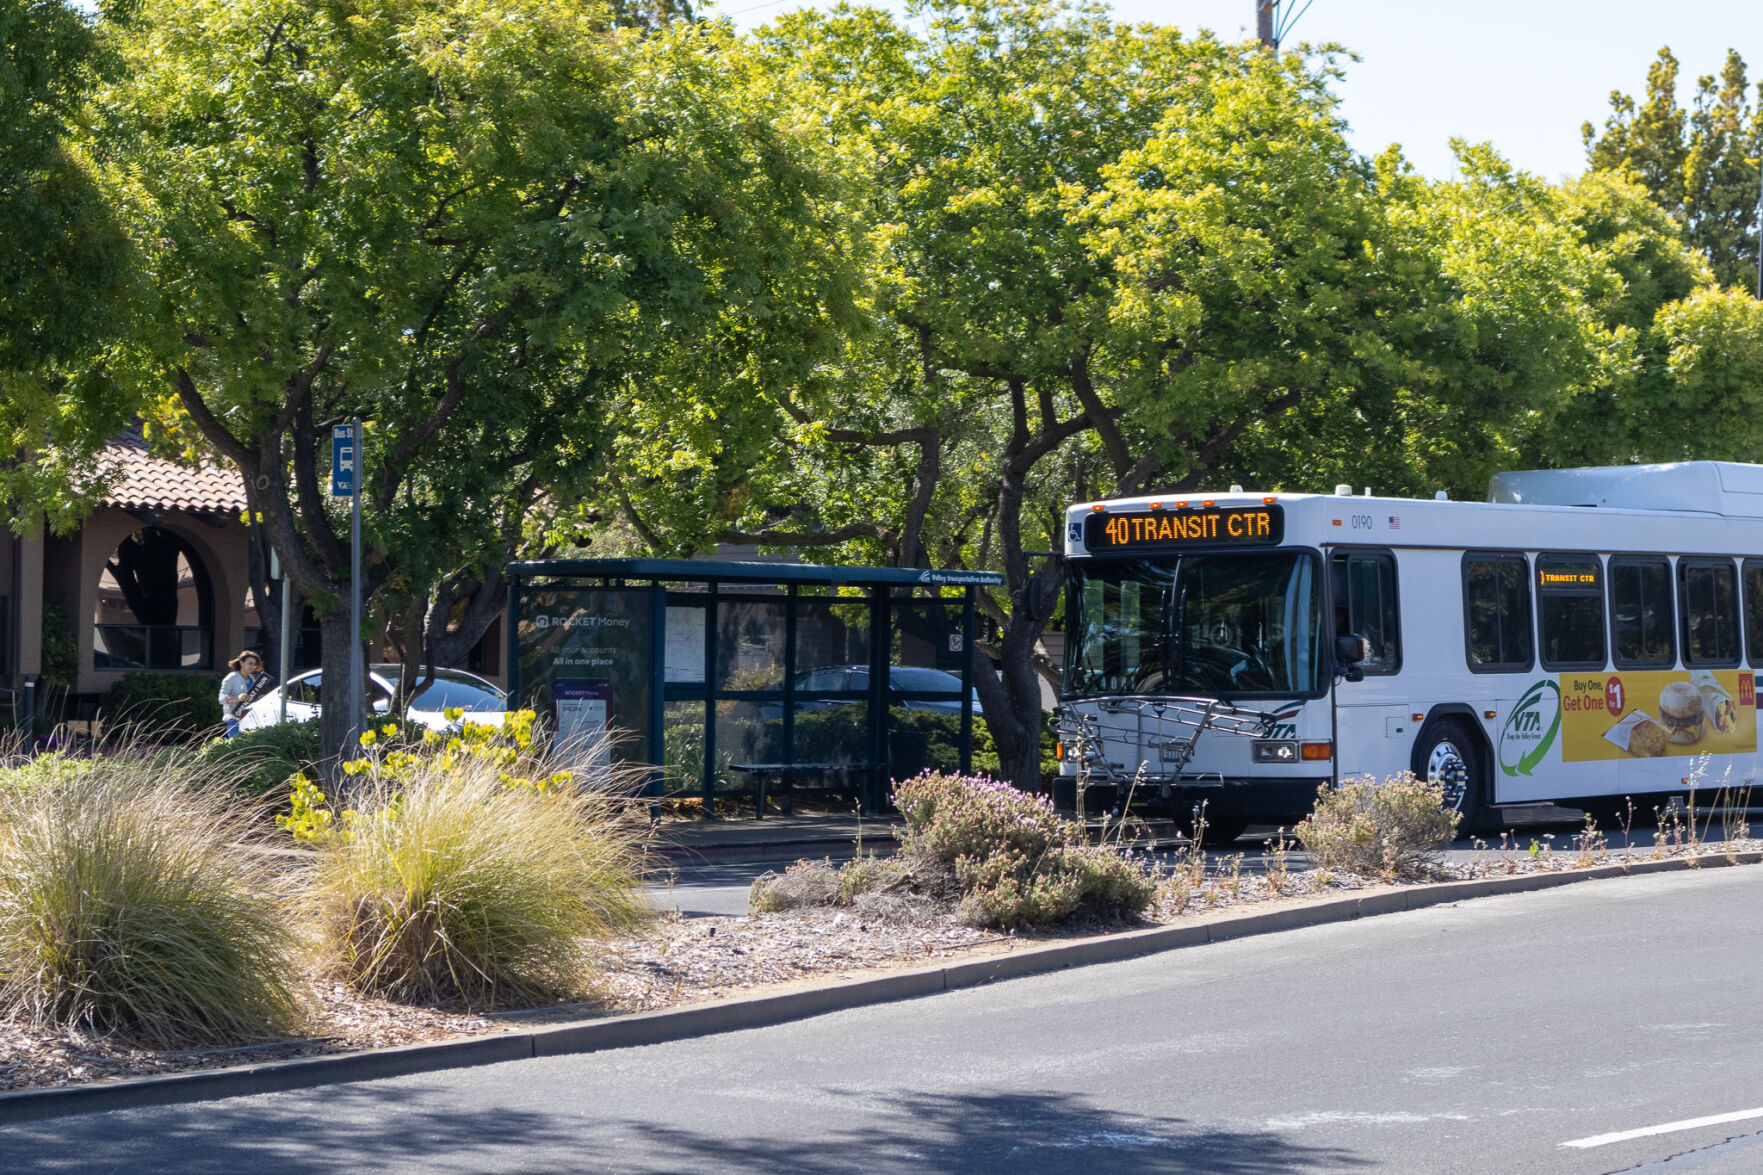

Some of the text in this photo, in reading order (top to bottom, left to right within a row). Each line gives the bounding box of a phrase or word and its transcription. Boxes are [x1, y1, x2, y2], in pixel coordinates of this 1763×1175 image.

[334, 428, 346, 438] Bus
[1105, 512, 1270, 545] 40 TRANSIT CTR
[1352, 515, 1373, 530] 0190
[1545, 574, 1577, 582] TRANSIT
[551, 617, 631, 628] ROCKET Money
[580, 646, 617, 654] accounts
[553, 657, 563, 665] All
[565, 657, 574, 665] in
[591, 657, 614, 667] place
[1573, 679, 1604, 694] Buy One,
[1563, 694, 1604, 712] Get One
[1514, 711, 1541, 731] VTA
